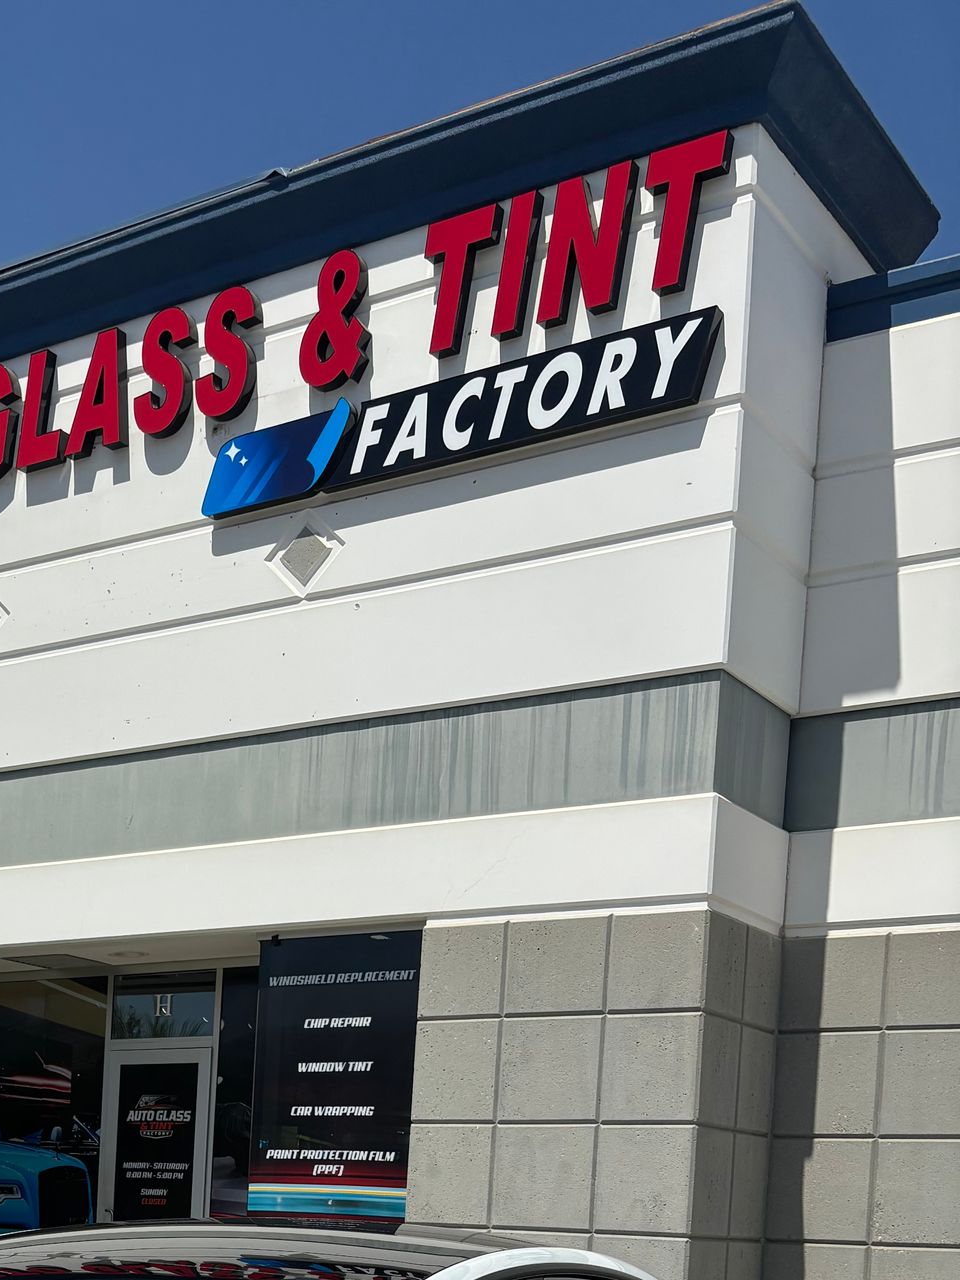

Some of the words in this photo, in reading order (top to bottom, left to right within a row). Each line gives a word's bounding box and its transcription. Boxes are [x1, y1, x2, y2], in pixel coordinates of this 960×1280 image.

[299, 248, 371, 391] &
[425, 129, 734, 359] TINT
[350, 317, 704, 474] FACTORY
[269, 973, 336, 987] WINDSHIELD
[336, 969, 417, 984] REPLACEMENT
[153, 993, 175, 1017] H
[303, 1018, 330, 1029] CHIP
[330, 1016, 372, 1028] REPAIR
[297, 1061, 346, 1073] WINDOW
[347, 1061, 374, 1072] TINT
[126, 1110, 155, 1121] AUTO
[155, 1110, 191, 1122] GLASS
[290, 1106, 313, 1116] CAR
[314, 1106, 375, 1117] WRAPPING
[150, 1122, 173, 1130] TINT
[265, 1149, 299, 1160] PAINT
[300, 1149, 368, 1161] PROTECTION
[368, 1151, 396, 1162] FILM
[141, 1171, 153, 1179] AM
[173, 1172, 184, 1180] PM
[141, 1188, 169, 1196] SUNDAY
